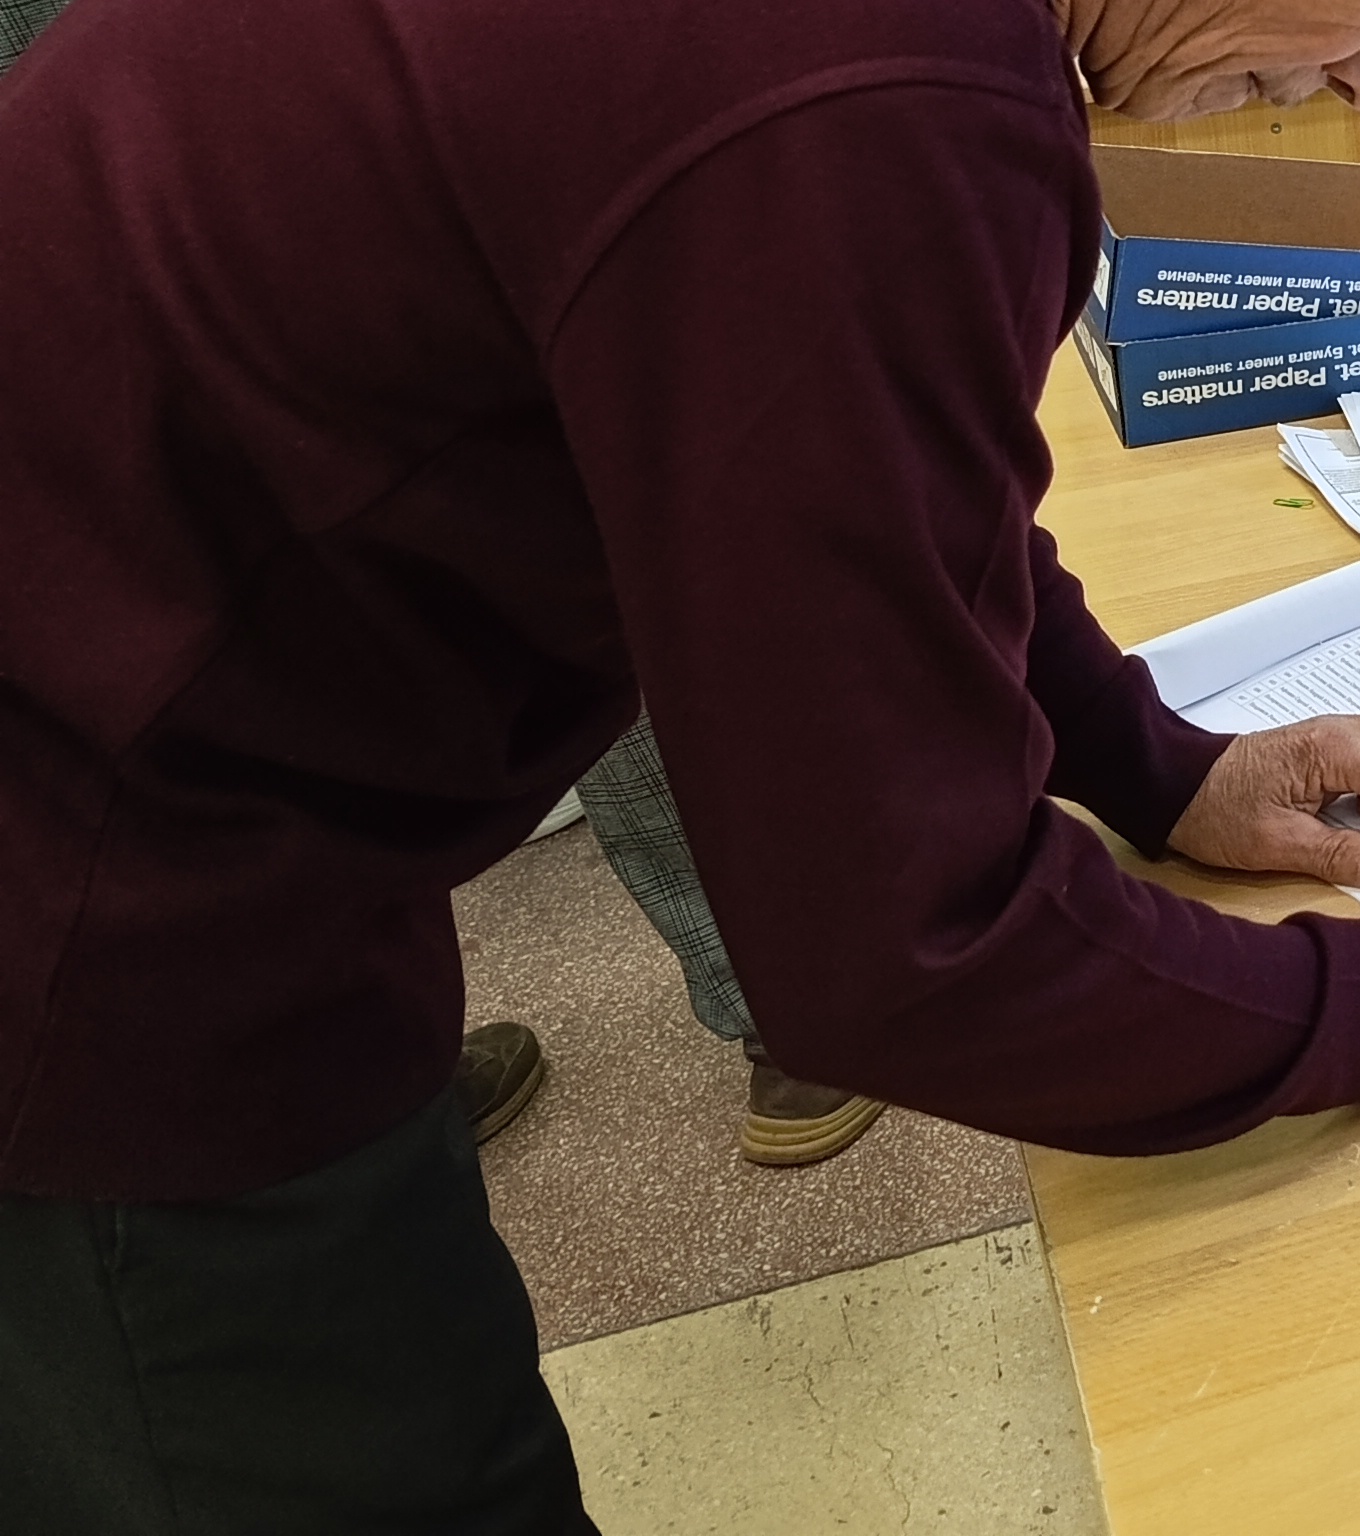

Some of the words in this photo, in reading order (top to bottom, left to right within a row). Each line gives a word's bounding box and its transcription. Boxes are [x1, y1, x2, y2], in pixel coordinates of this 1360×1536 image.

[1157, 269, 1231, 285] значение
[1235, 273, 1281, 287] имеет
[1287, 275, 1341, 290] Бумага
[1136, 287, 1236, 309] matters
[1243, 290, 1319, 316] Paper
[1236, 354, 1283, 371] имеет
[1288, 345, 1342, 364] Бумага
[1157, 361, 1232, 382] значение
[1249, 366, 1325, 392] Paper
[1141, 378, 1241, 407] matters
